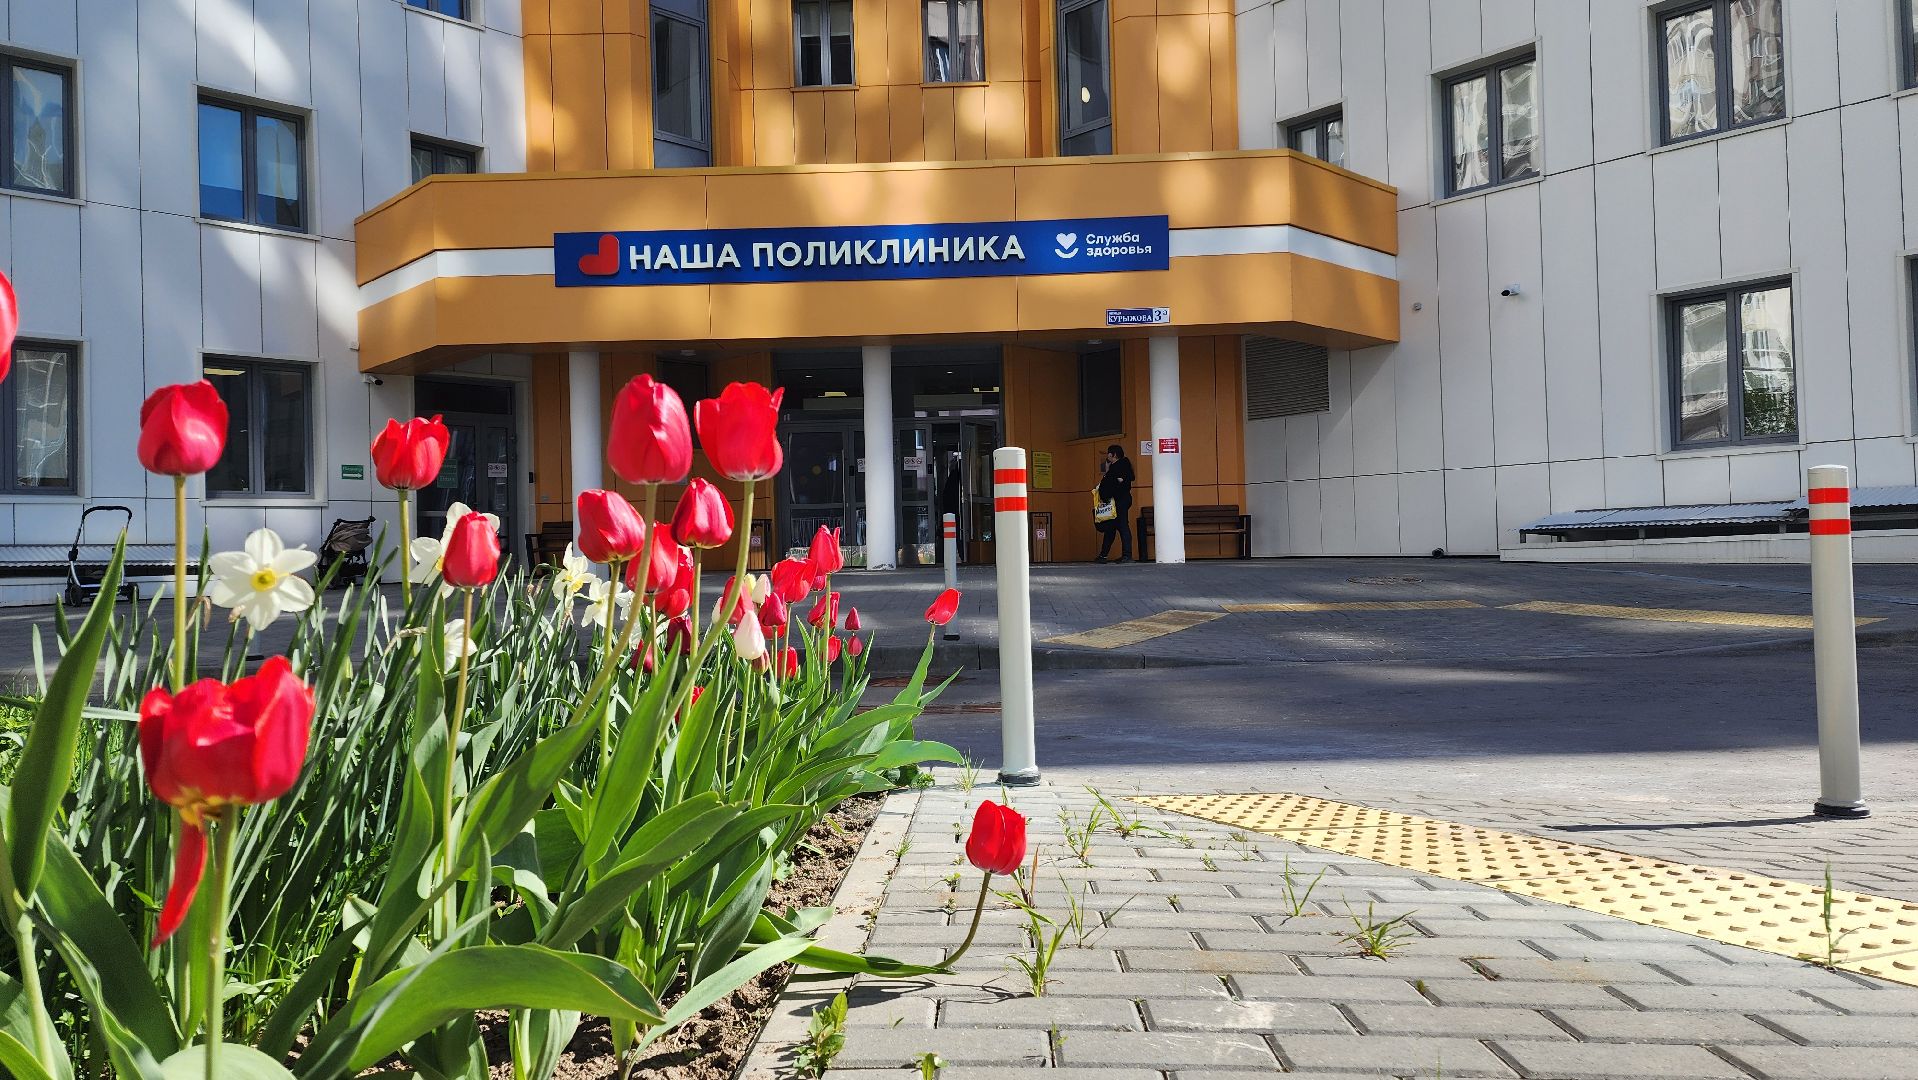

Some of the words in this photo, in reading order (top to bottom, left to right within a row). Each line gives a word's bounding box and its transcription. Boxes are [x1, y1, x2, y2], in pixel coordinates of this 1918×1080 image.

[1086, 232, 1140, 245] Служба
[629, 244, 741, 271] НАША
[753, 235, 1026, 268] ПОЛИКЛИНИКА
[1088, 246, 1152, 257] здоровья
